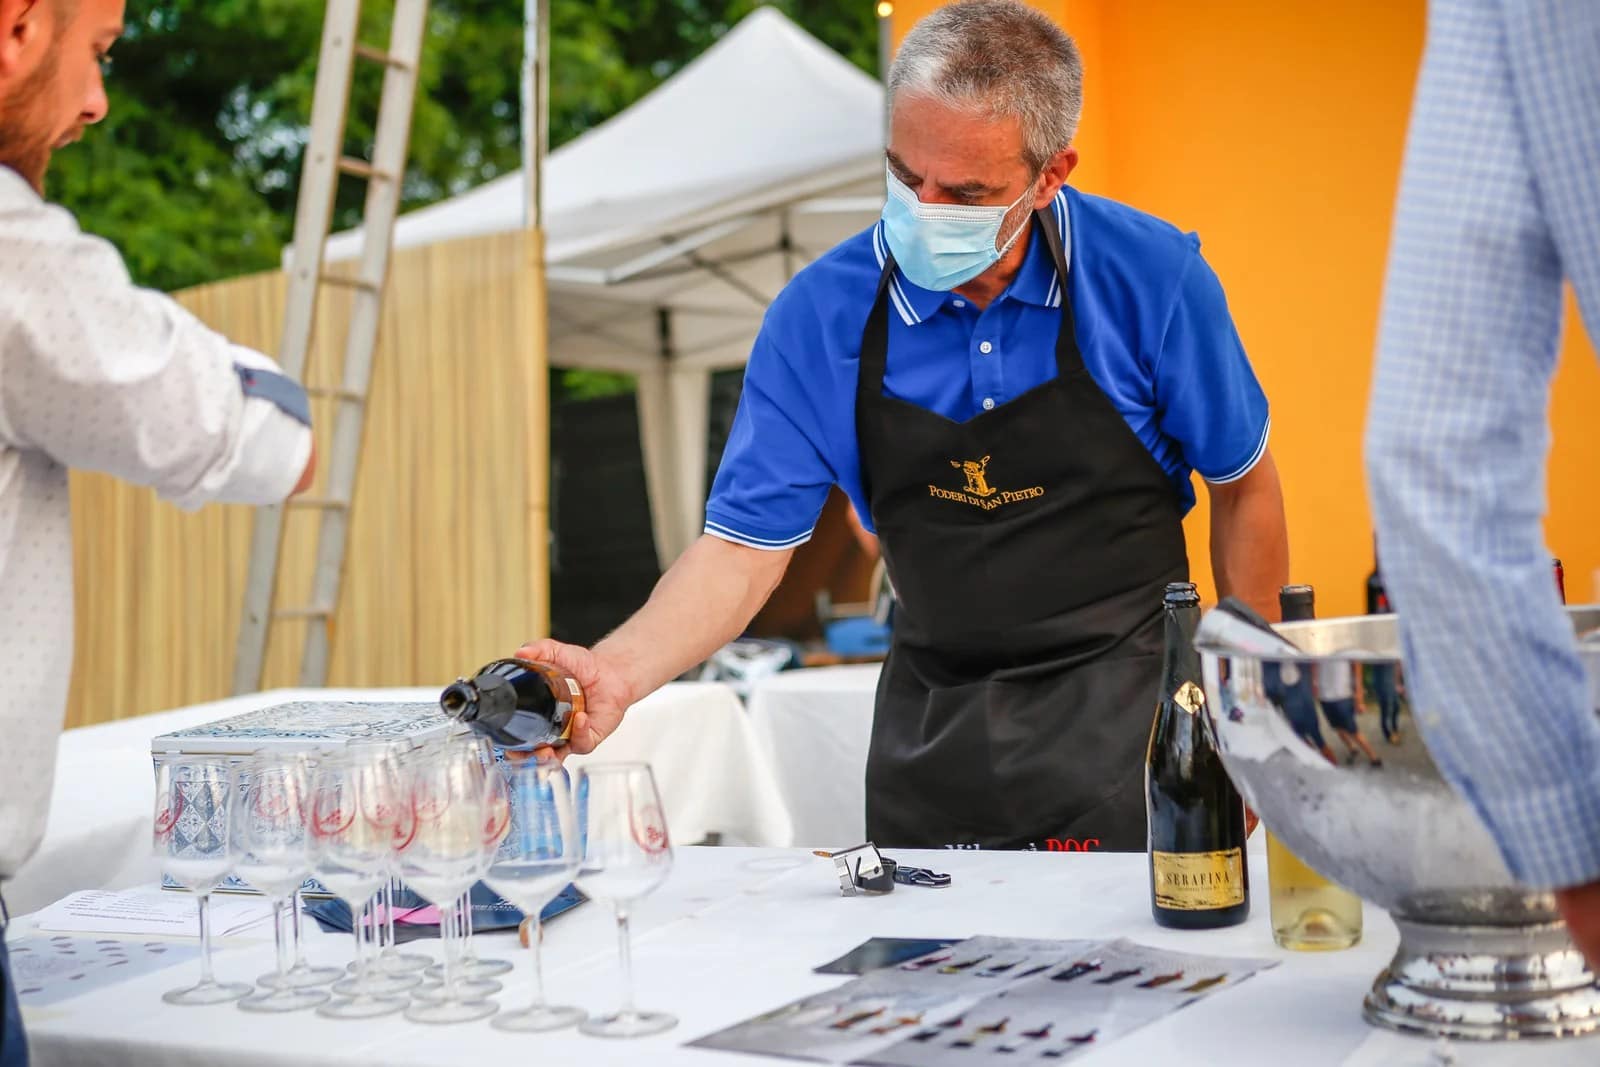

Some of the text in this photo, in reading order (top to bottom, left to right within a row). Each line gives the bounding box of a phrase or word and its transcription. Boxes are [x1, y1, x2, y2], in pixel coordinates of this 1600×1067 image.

[928, 485, 1044, 510] PODERI DI SAN PIETRO
[1166, 871, 1230, 886] SERAFINA
